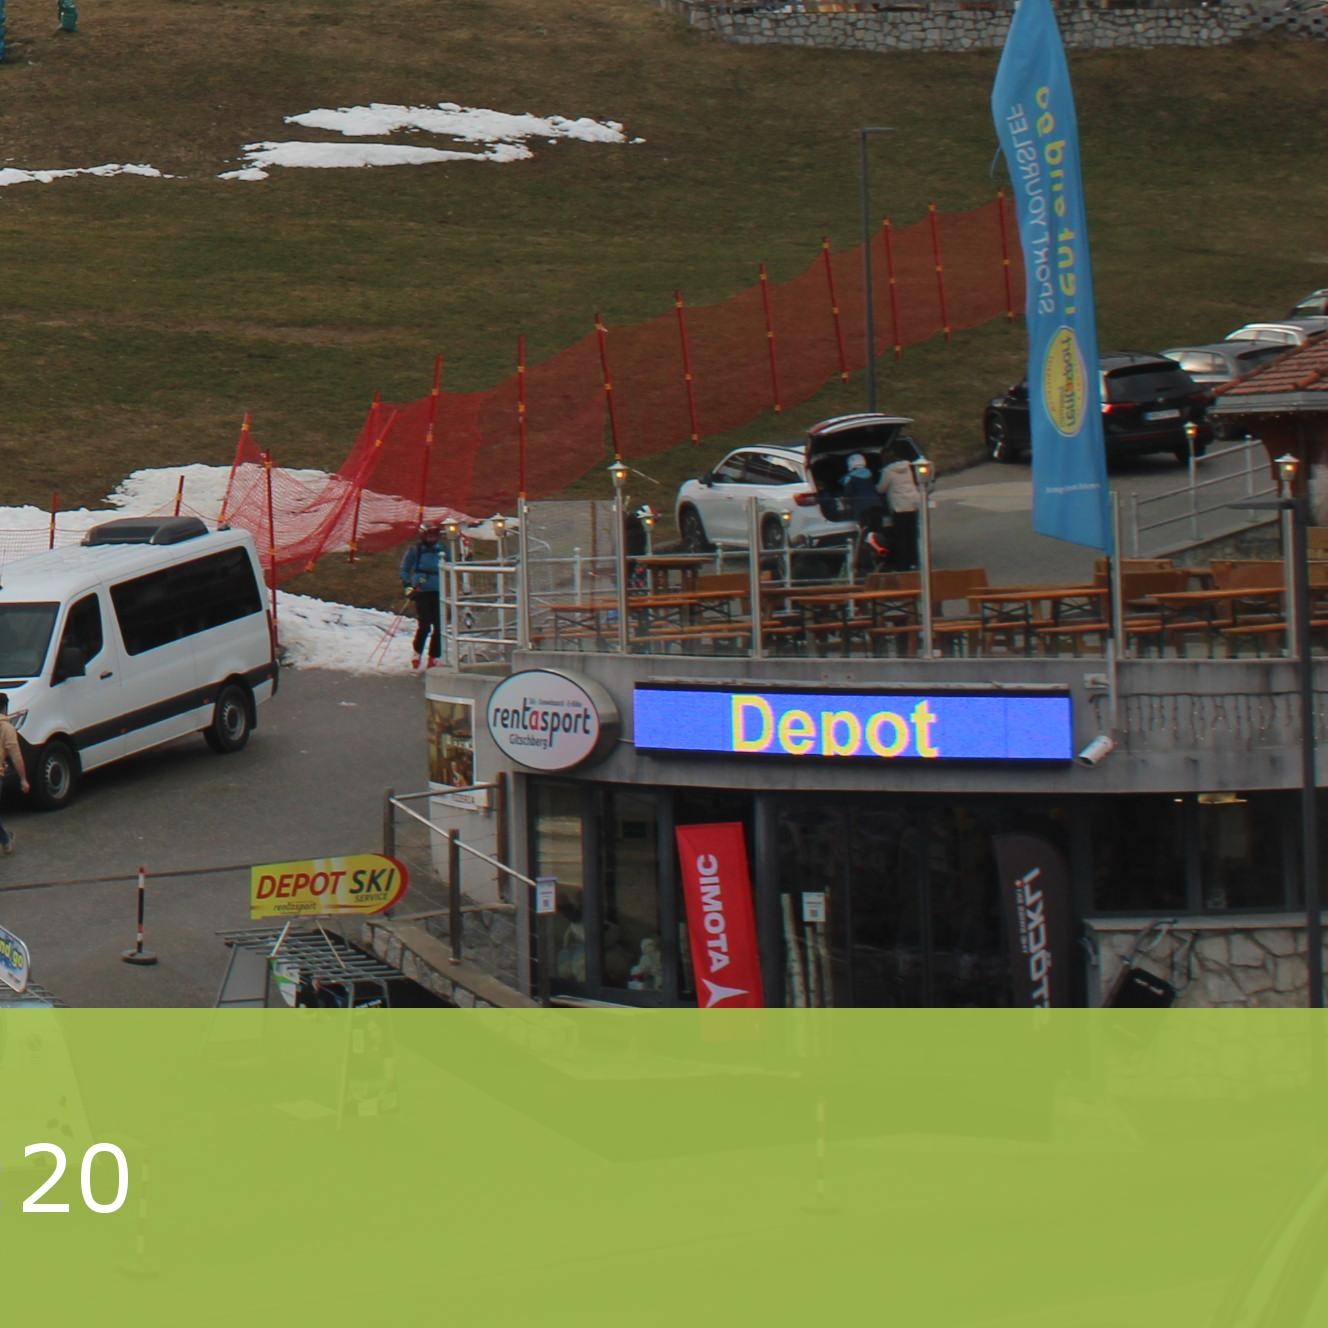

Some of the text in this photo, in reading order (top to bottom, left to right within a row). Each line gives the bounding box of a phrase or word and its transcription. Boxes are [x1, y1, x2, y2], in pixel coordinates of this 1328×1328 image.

[493, 698, 591, 748] rentasport
[731, 694, 940, 758] Depot
[256, 868, 395, 900] DEPOT SKI
[354, 892, 388, 903] SERVICE
